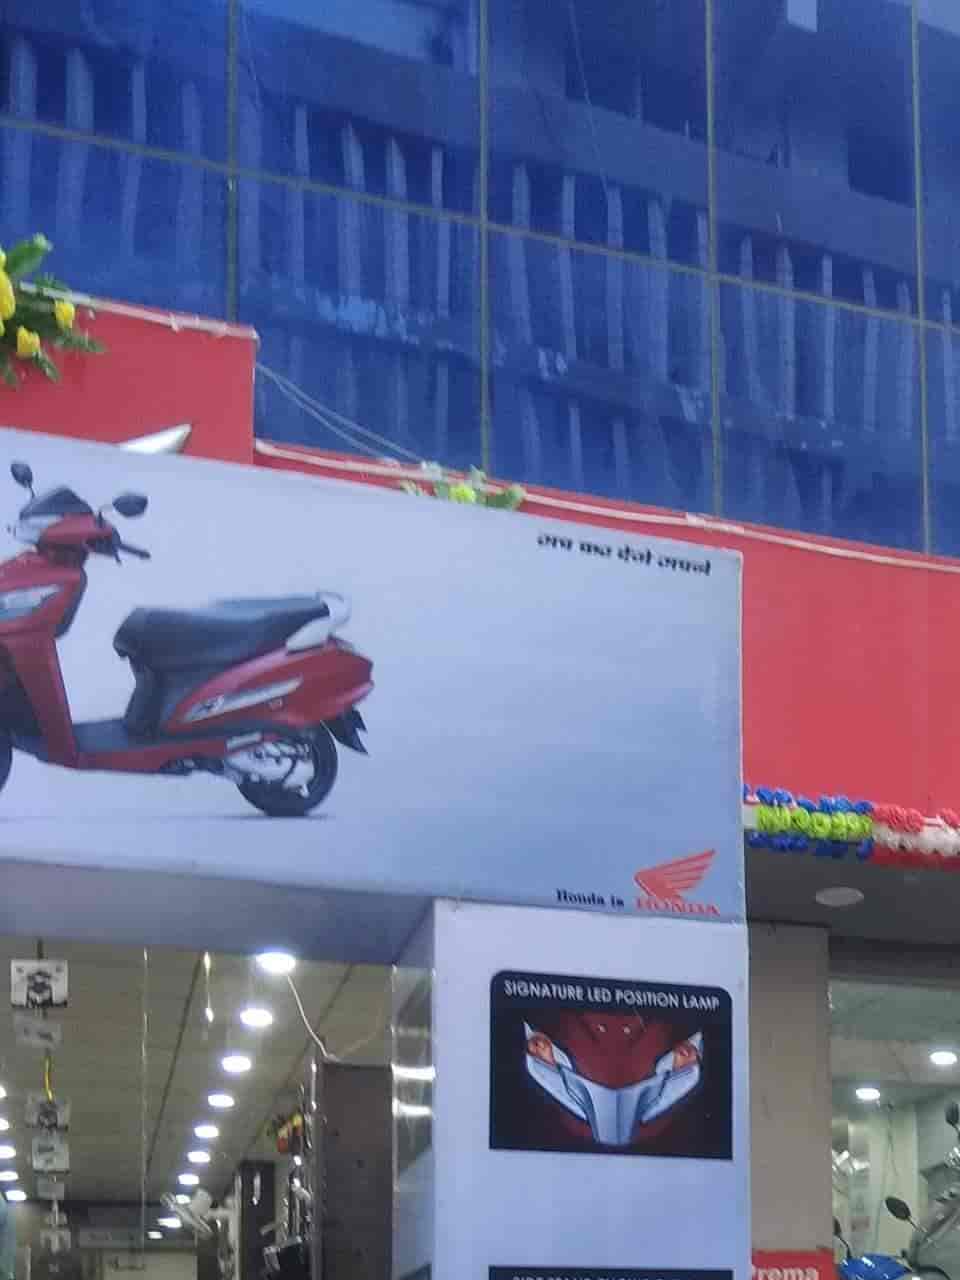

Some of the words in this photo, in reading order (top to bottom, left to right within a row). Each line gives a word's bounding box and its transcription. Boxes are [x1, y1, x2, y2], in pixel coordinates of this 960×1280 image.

[503, 979, 584, 1002] SIGNATURE
[586, 986, 612, 1004] LED
[615, 988, 679, 1010] POSITION
[682, 994, 720, 1012] LAMP
